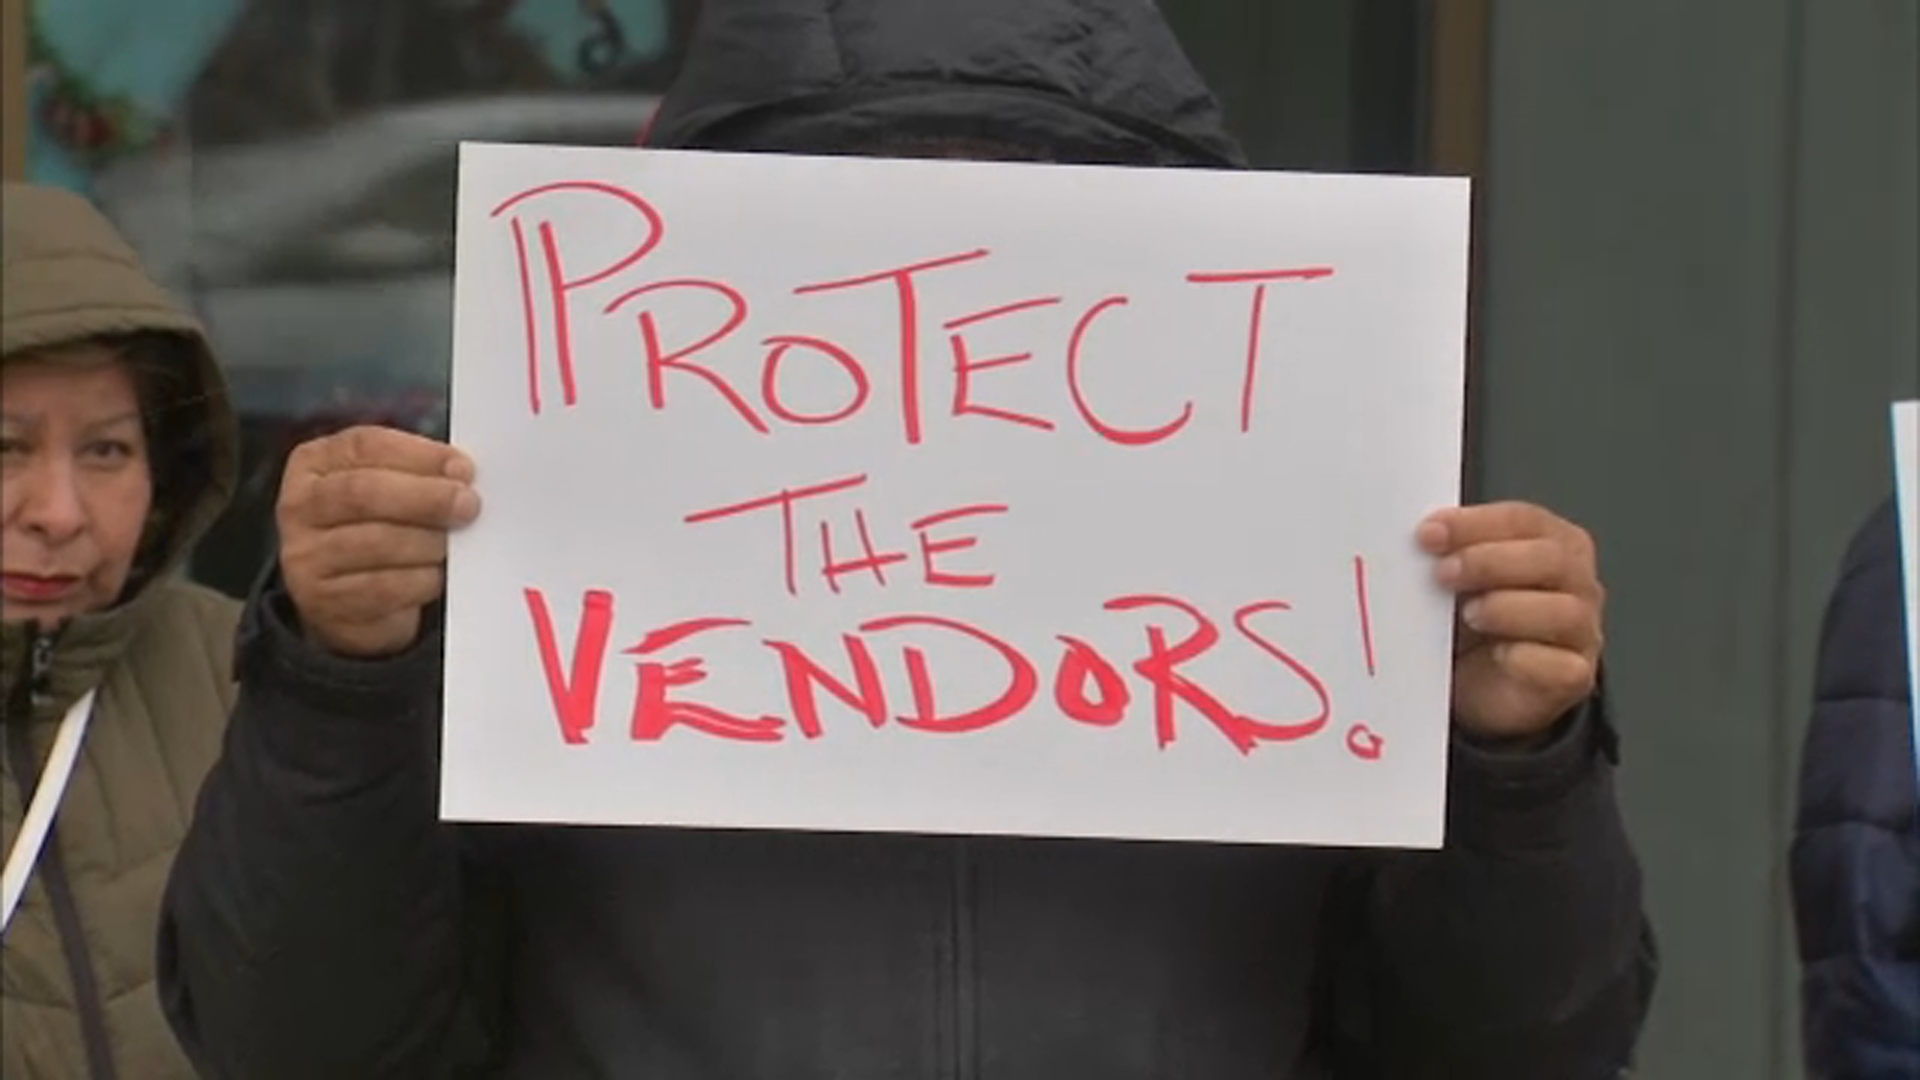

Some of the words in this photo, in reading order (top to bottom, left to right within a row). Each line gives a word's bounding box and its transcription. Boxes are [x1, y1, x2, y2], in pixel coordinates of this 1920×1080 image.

[491, 181, 1334, 445] PROTECT
[684, 474, 1009, 597] THE
[524, 556, 1384, 762] VENDORS!
